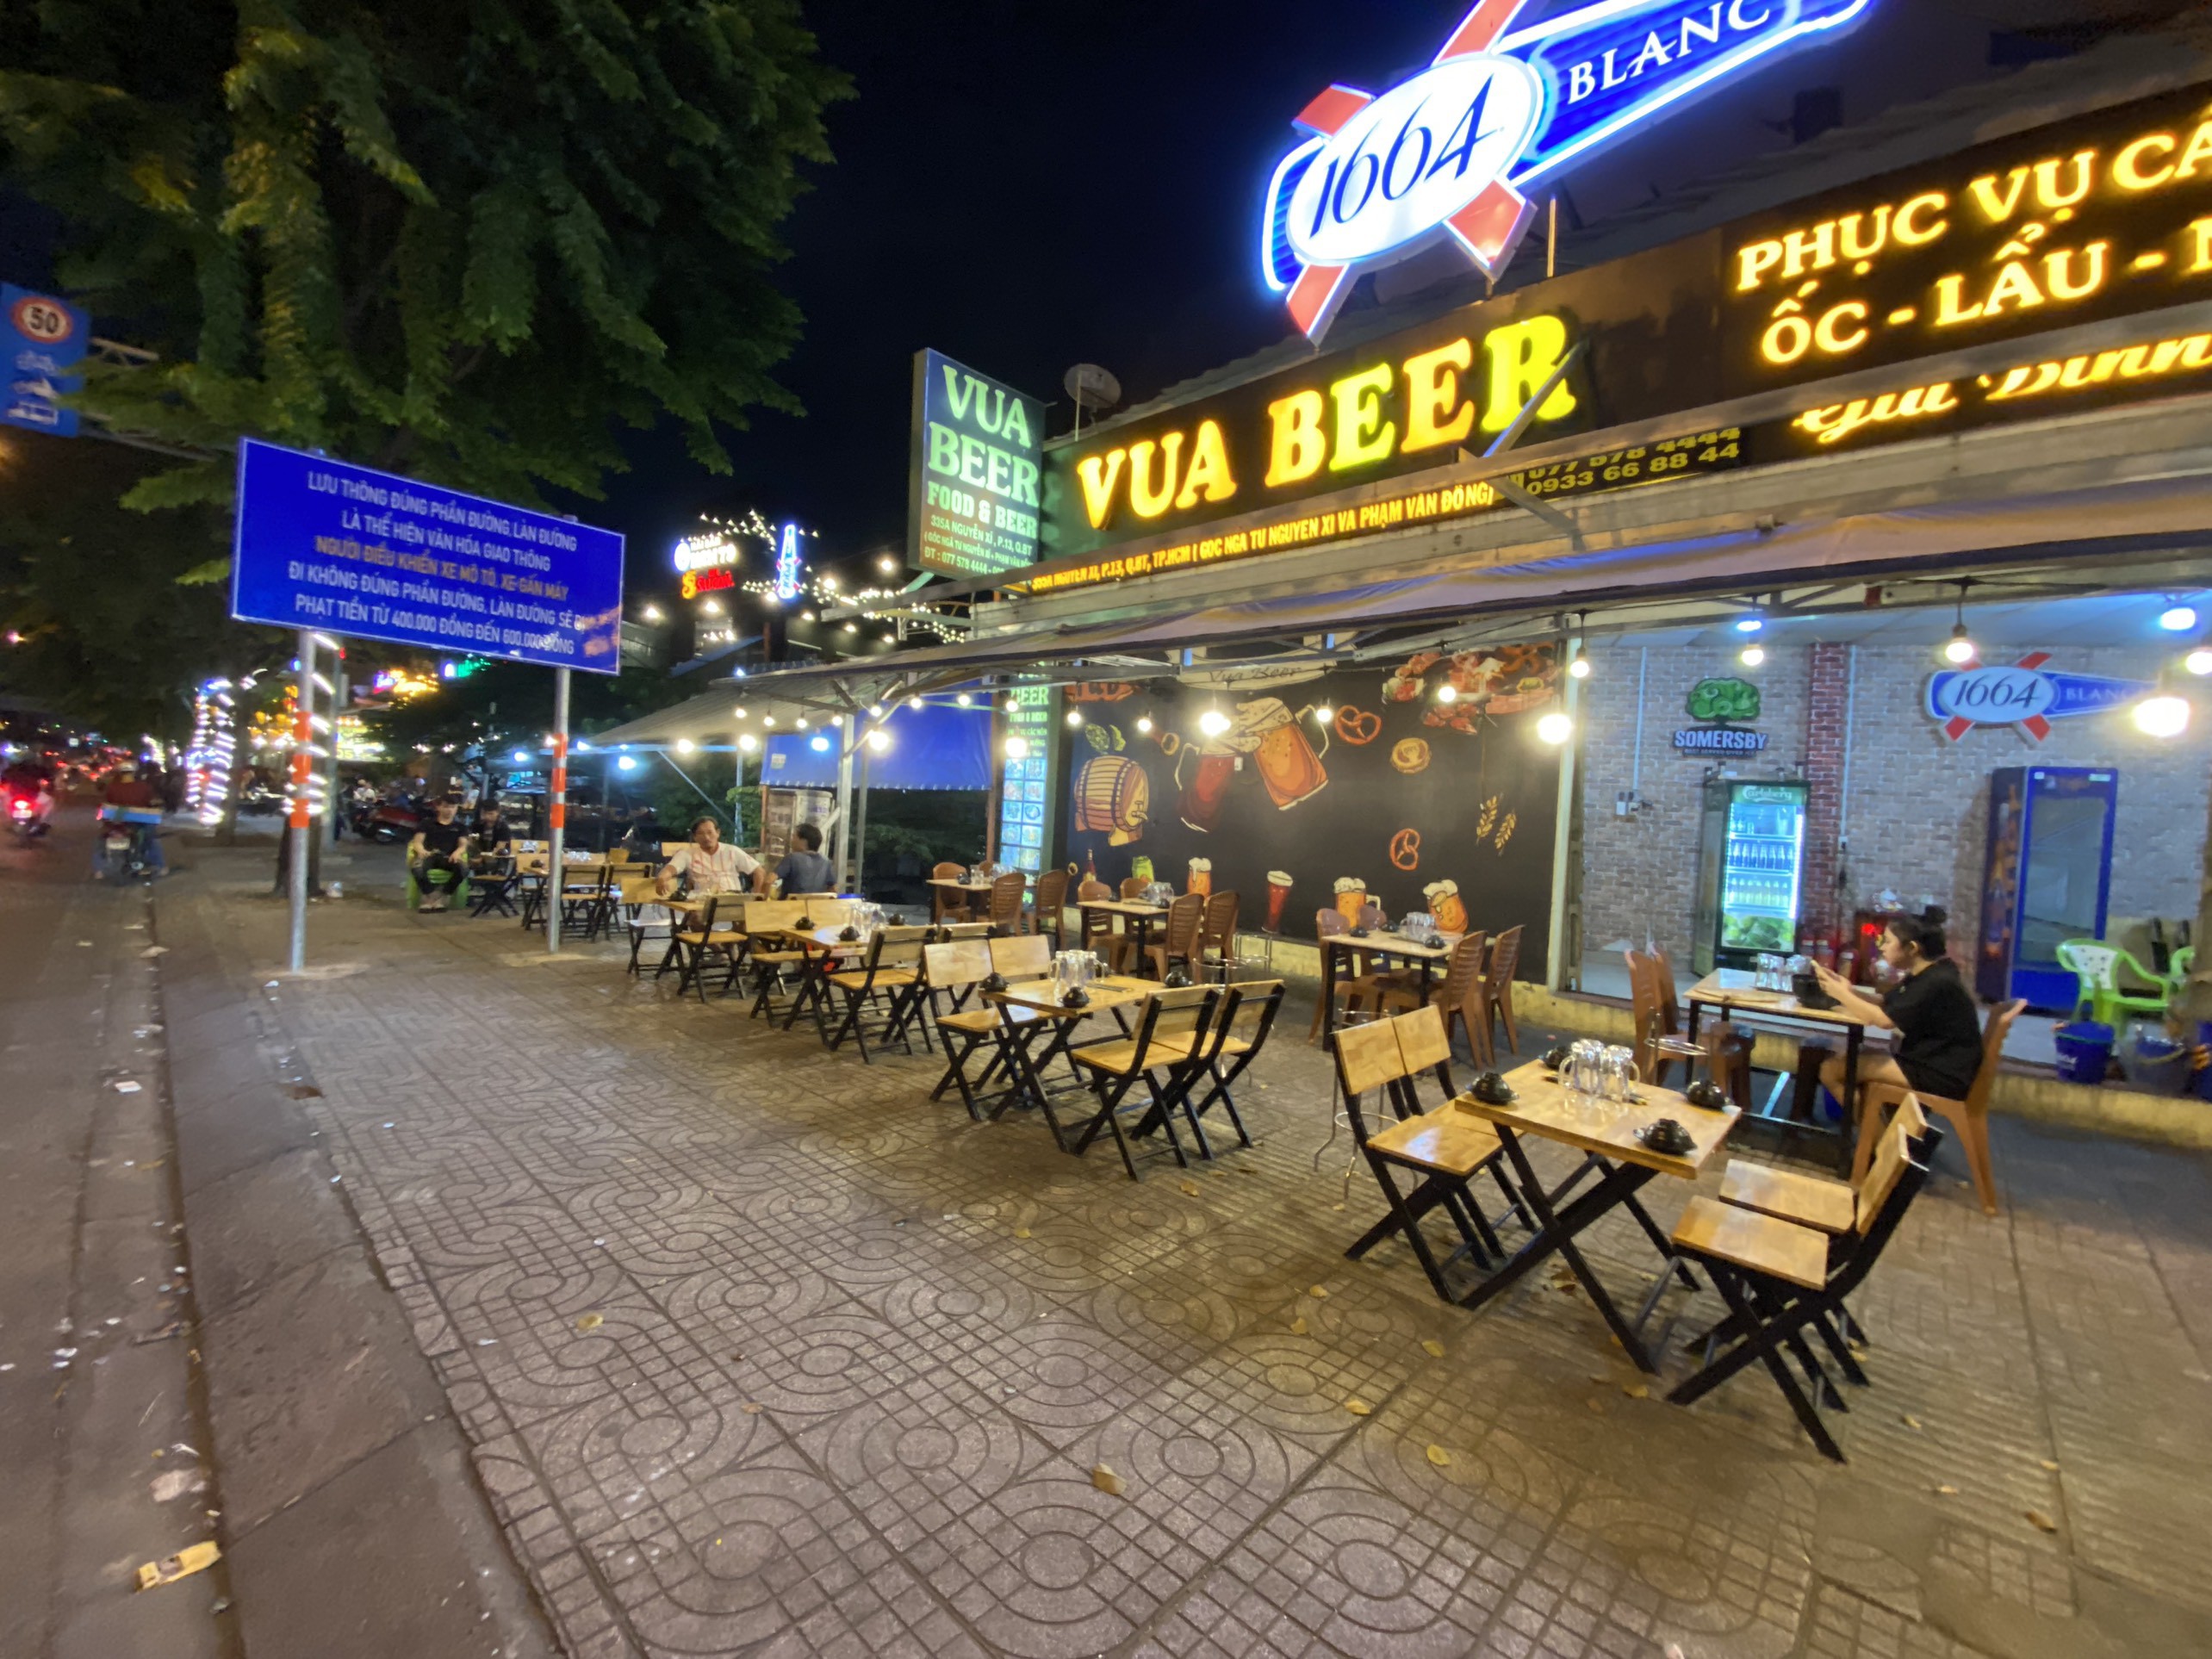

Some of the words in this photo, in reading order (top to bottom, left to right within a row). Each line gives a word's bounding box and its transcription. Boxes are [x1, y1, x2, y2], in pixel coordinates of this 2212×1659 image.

[1567, 0, 1770, 105] BLANC
[1308, 72, 1505, 240] 1664
[1736, 190, 1949, 293] PHỤC
[1969, 149, 2099, 222] VỤ
[28, 306, 59, 334] 50
[1760, 280, 1869, 365] ỐC
[1935, 223, 2109, 326] LẨU
[942, 364, 1032, 449] VUA
[1077, 419, 1238, 531] VUA
[1264, 315, 1577, 488] BEER
[928, 420, 1040, 508] BEER
[1526, 470, 1594, 495] 0933
[1603, 462, 1640, 481] 66
[1649, 452, 1688, 473] 88
[1698, 442, 1740, 462] 44
[341, 479, 388, 506] THÔNG
[390, 488, 427, 515] ĐÚNG
[927, 481, 975, 518] FOOD
[979, 500, 991, 524] &
[994, 505, 1037, 540] BEER
[1359, 500, 1402, 528] PHẠM
[341, 506, 361, 531] LÀ
[393, 520, 425, 546] HIỆN
[483, 543, 511, 562] GIAO
[513, 549, 551, 572] THÔNG
[288, 560, 304, 581] ĐI
[308, 564, 358, 590] KHÔNG
[360, 572, 400, 598] ĐÚNG
[441, 561, 457, 580] XE
[295, 593, 335, 620] PHẠT
[391, 610, 438, 633] 400.000
[1954, 674, 2041, 709] 1664
[1675, 730, 1767, 749] SOMERSBY
